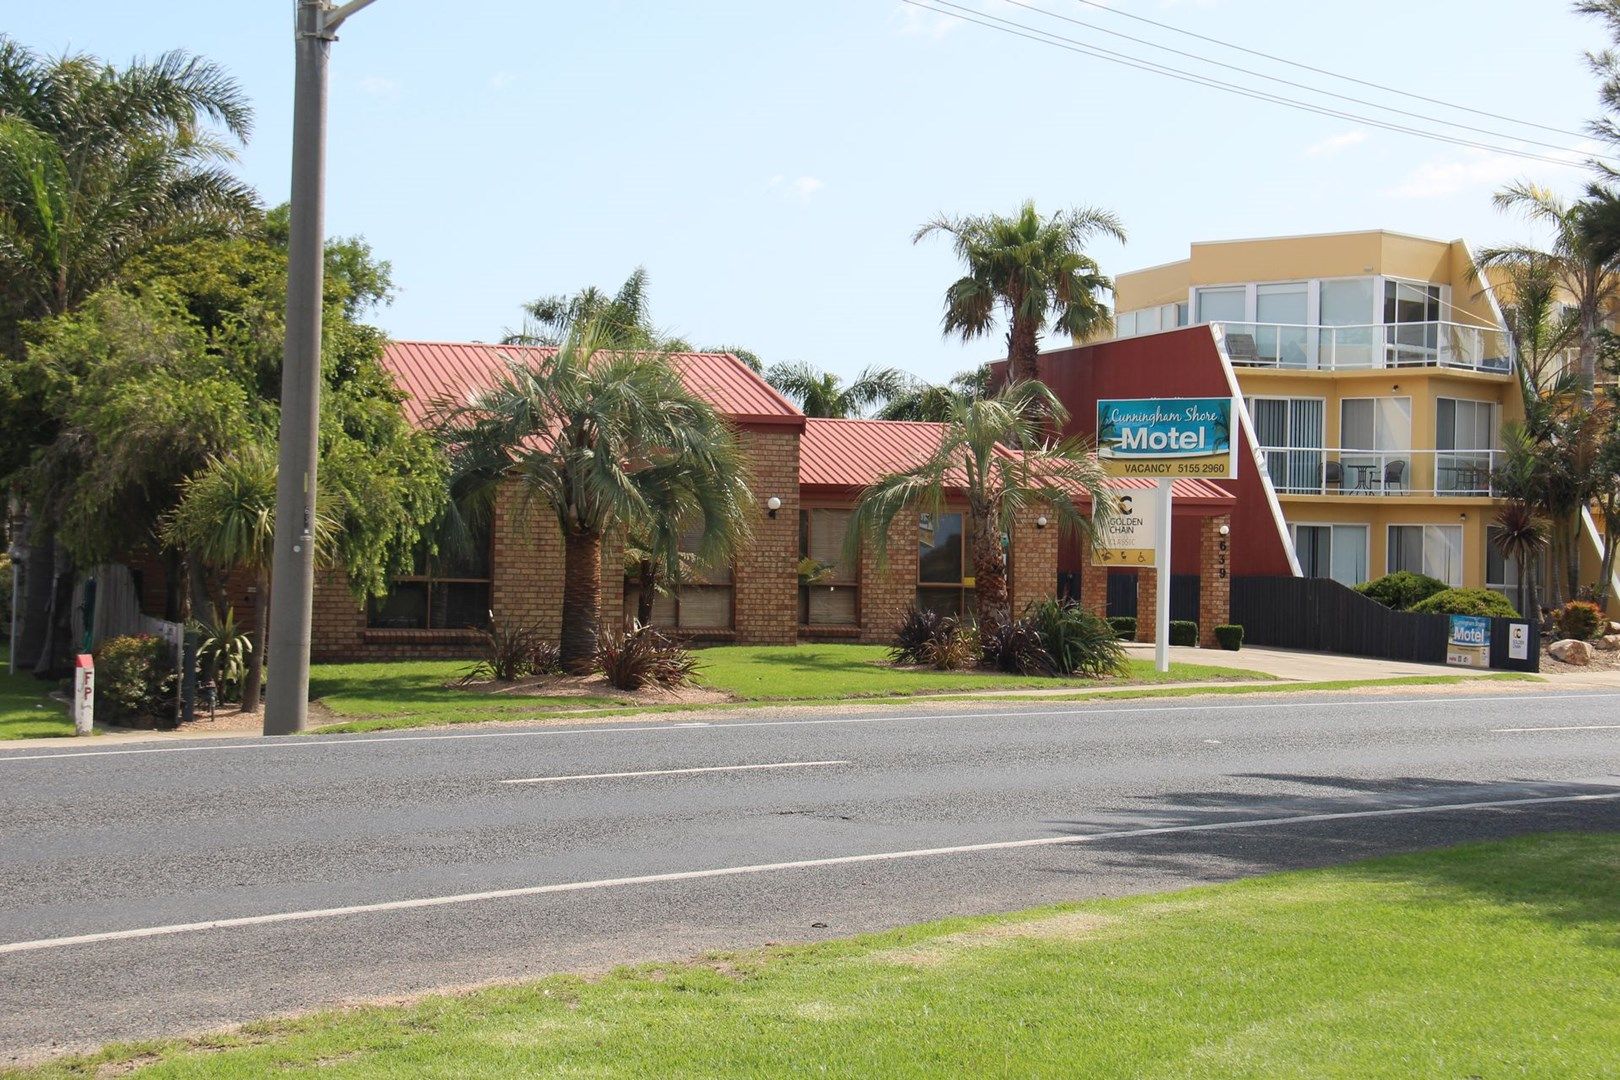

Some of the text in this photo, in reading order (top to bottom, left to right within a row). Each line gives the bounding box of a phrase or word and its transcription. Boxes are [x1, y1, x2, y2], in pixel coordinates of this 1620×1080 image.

[1111, 404, 1218, 427] Cunningham Shore
[1121, 426, 1205, 450] Motel
[1124, 463, 1225, 474] VACANCY 5155 2960
[1110, 517, 1144, 526] GOLDEN
[1109, 526, 1134, 534] CHAIN
[1218, 541, 1227, 578] 639
[1454, 626, 1485, 642] Motel
